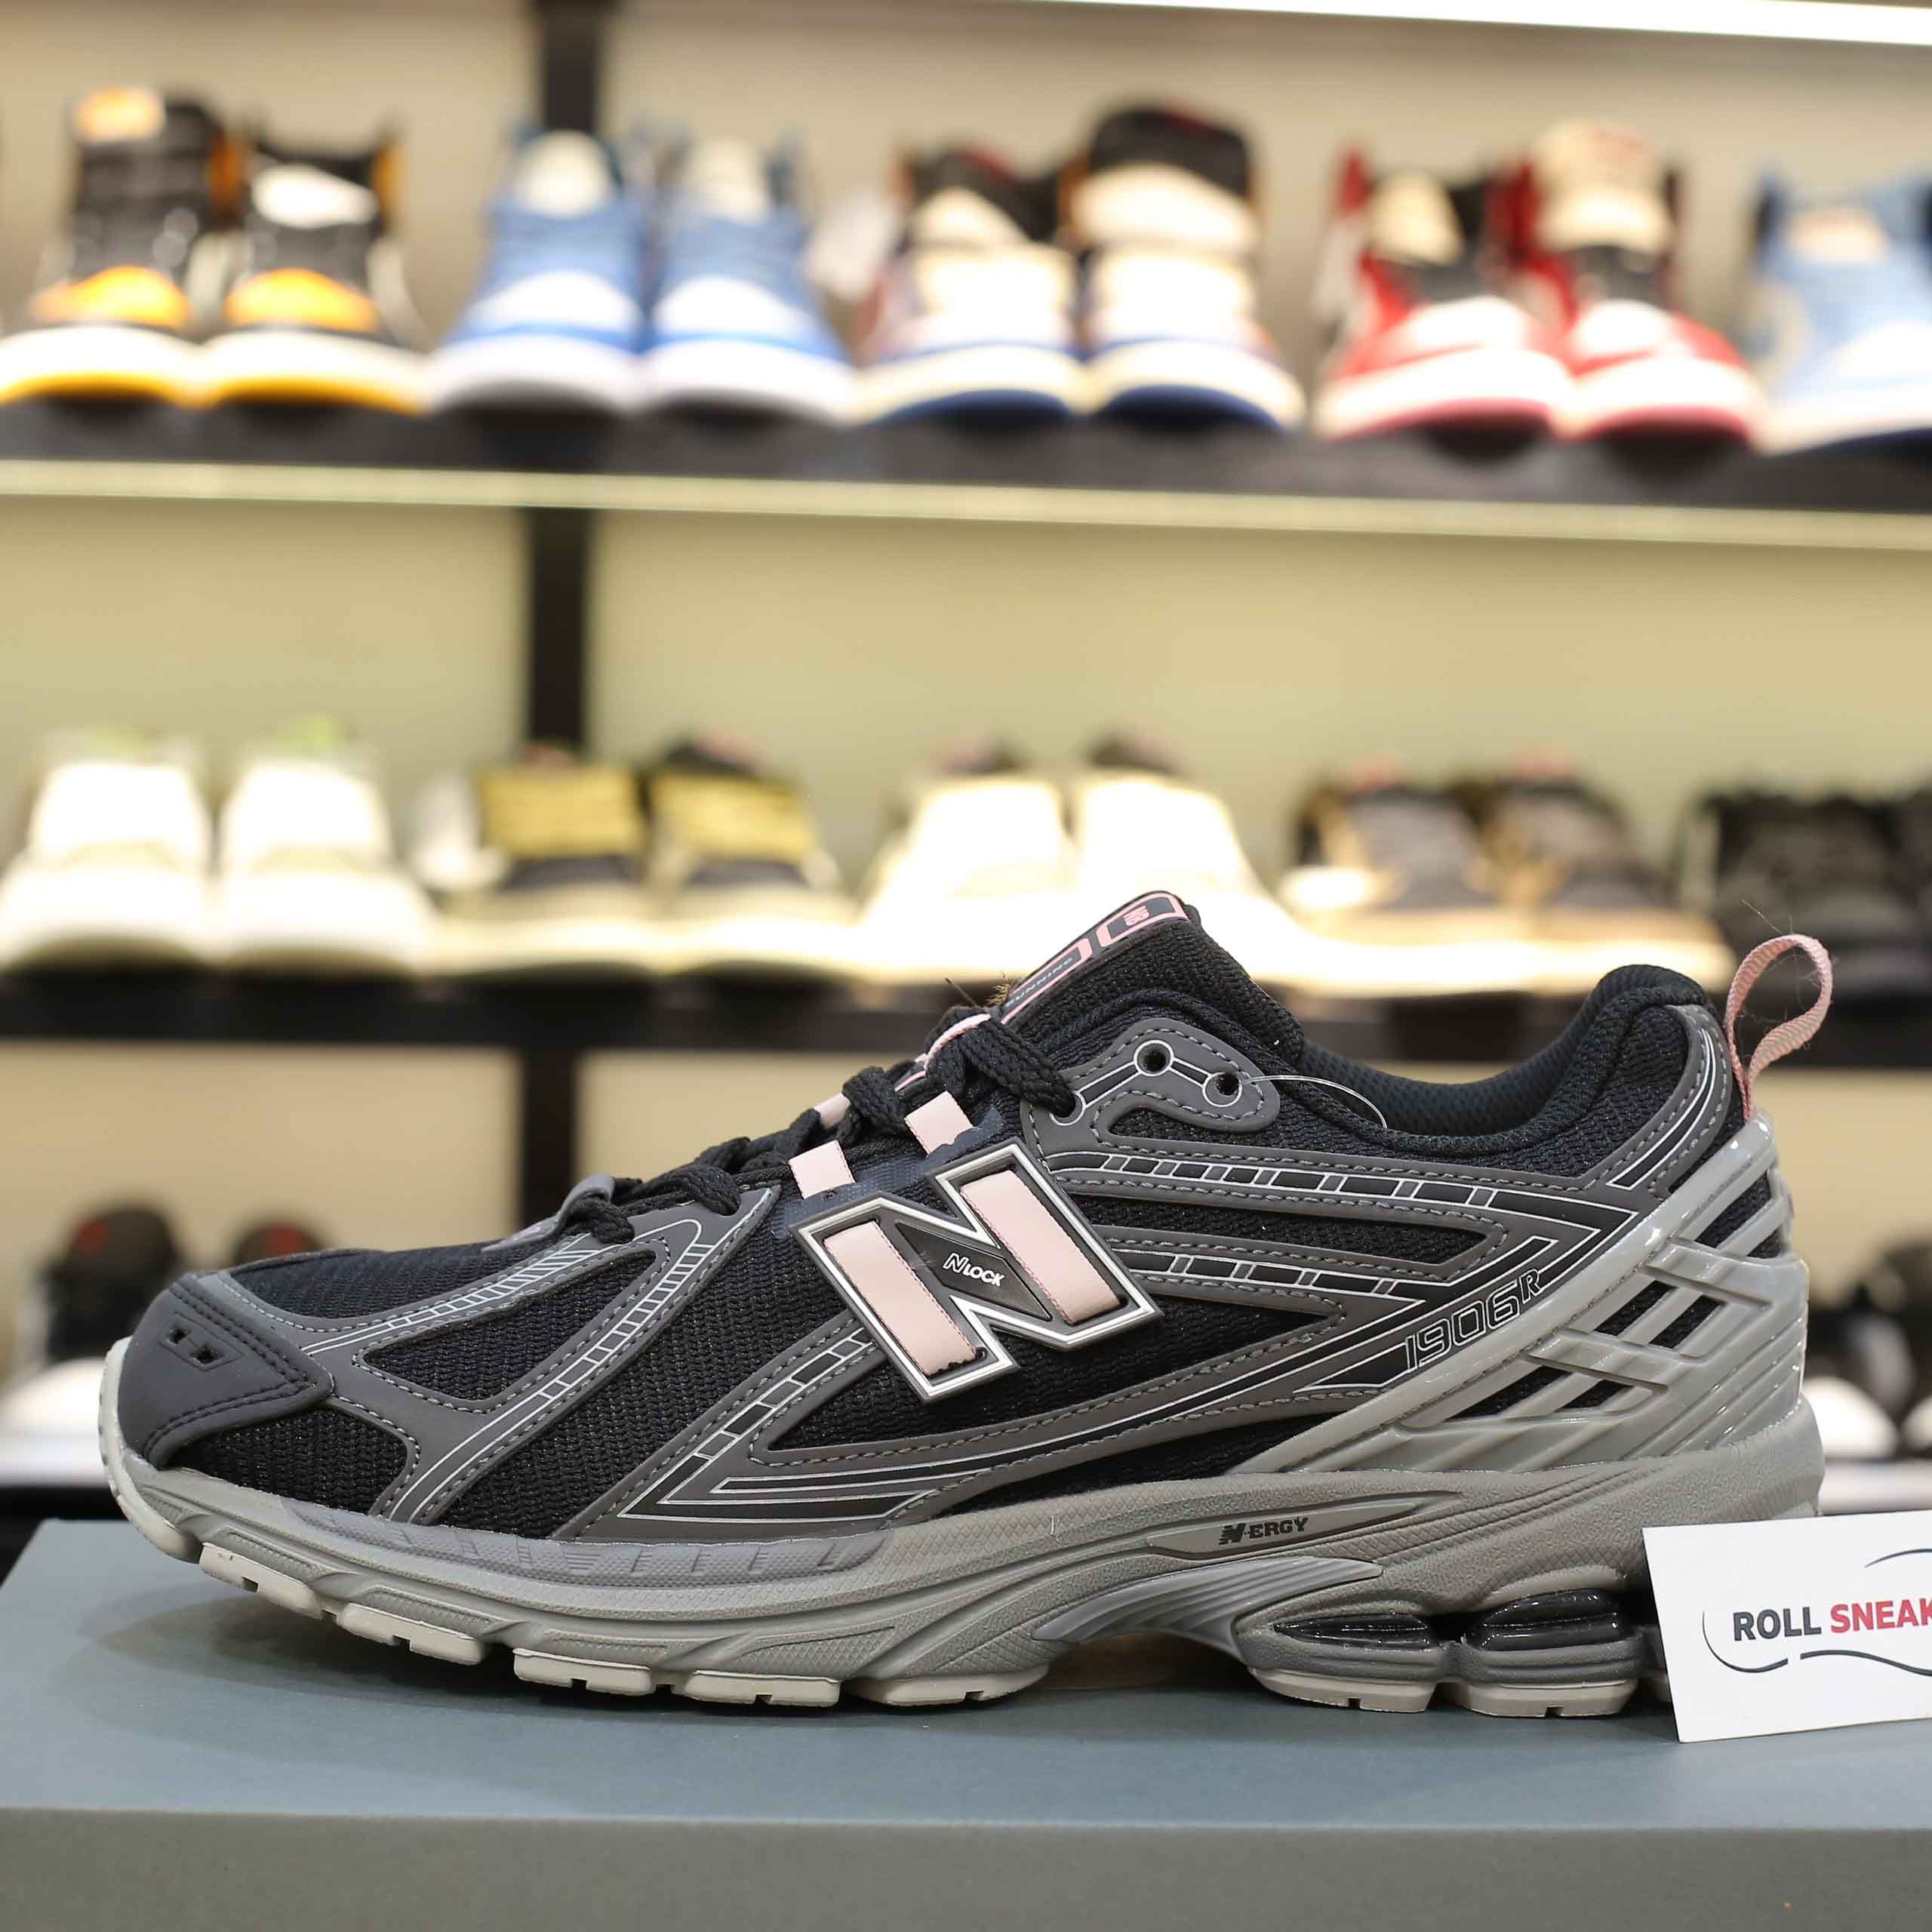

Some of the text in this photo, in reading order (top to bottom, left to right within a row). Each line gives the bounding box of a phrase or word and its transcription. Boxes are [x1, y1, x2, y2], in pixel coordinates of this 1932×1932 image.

[942, 1252, 1005, 1287] NLOCK
[1404, 1268, 1543, 1374] 1906R
[1733, 1607, 1822, 1641] ROLL
